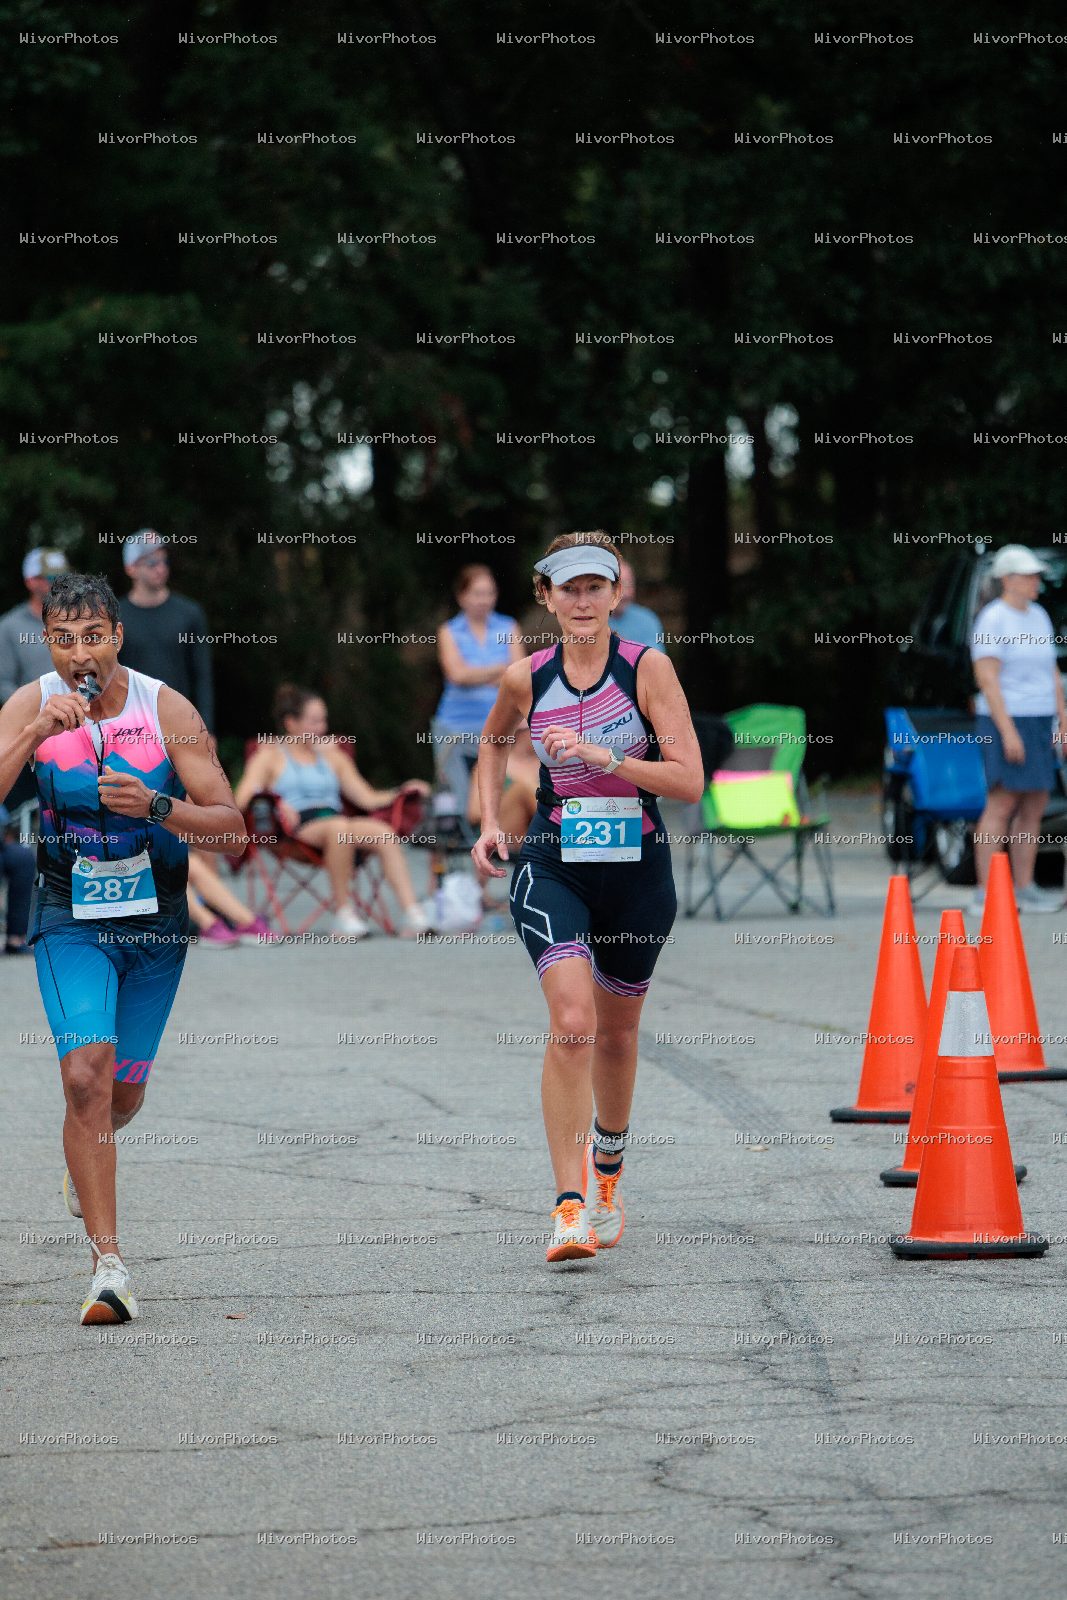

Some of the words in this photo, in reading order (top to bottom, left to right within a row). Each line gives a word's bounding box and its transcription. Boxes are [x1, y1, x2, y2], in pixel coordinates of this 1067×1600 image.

[602, 712, 633, 734] 2XU
[575, 821, 626, 845] 231
[84, 876, 141, 901] 287
